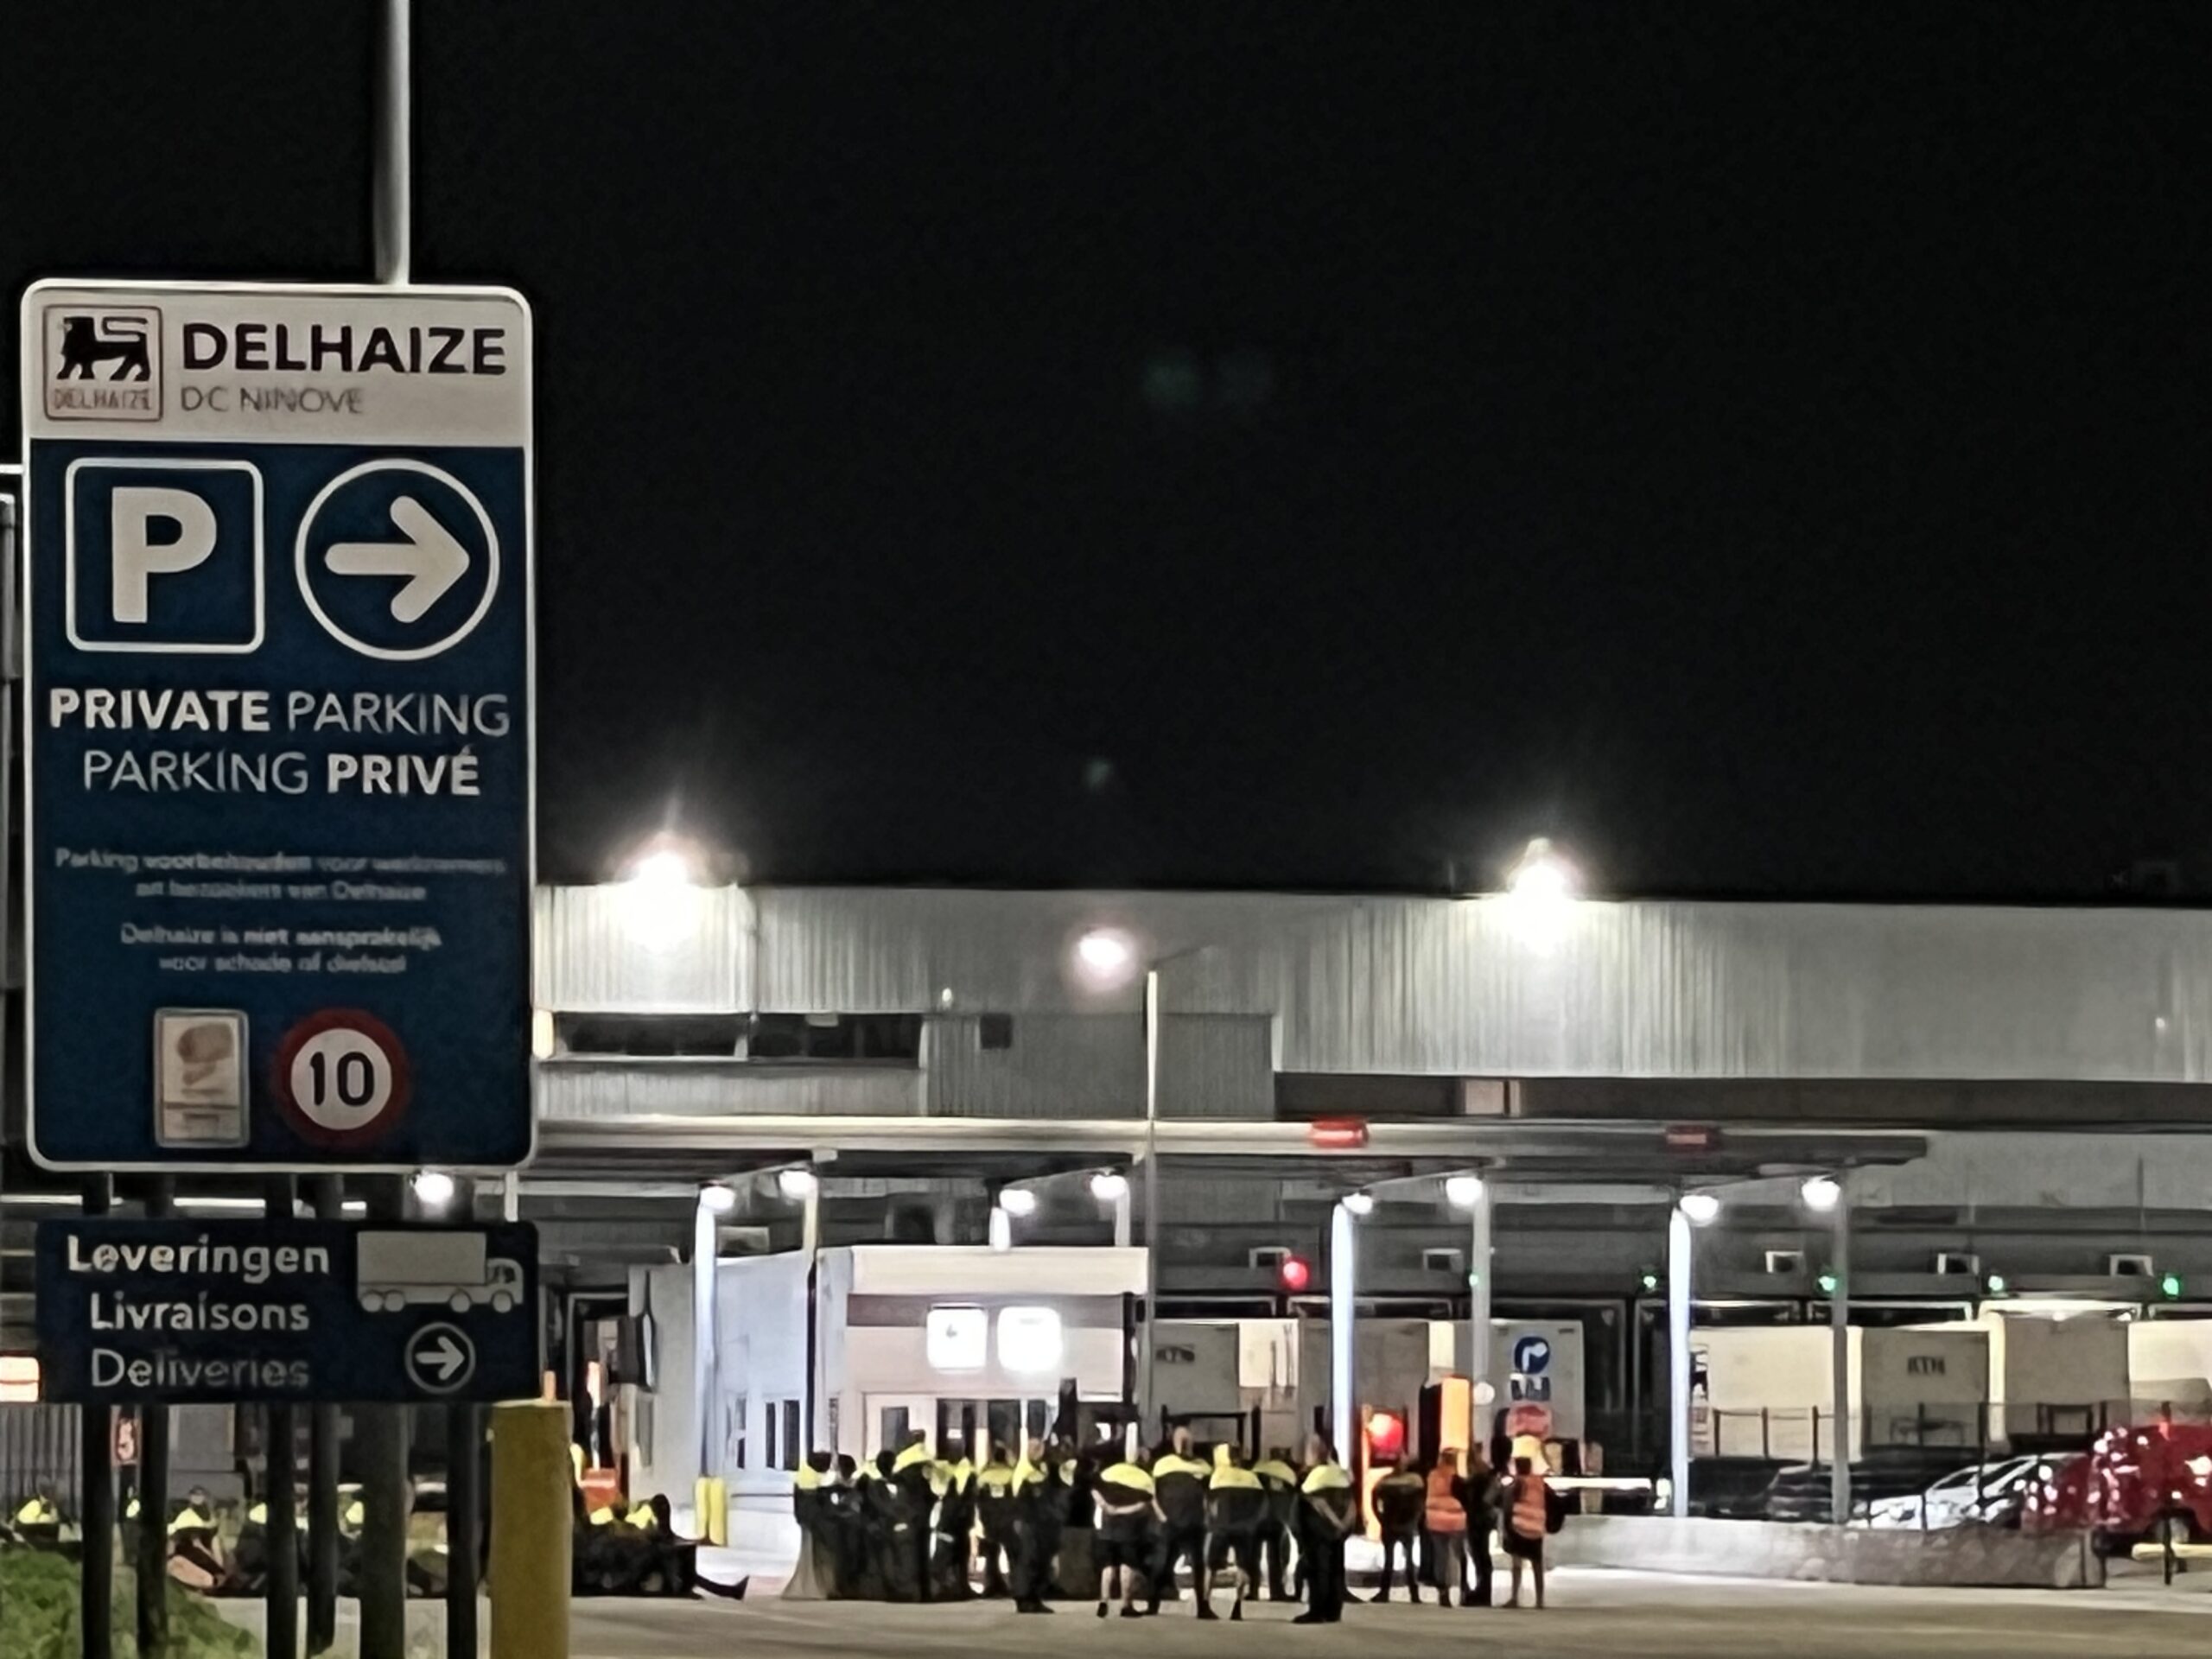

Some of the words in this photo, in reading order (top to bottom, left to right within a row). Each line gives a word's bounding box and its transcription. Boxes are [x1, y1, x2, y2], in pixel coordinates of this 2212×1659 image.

[182, 321, 508, 376] DELHAIZE
[54, 388, 151, 410] DELHAIZE
[181, 386, 229, 412] DC
[240, 386, 365, 415] NINOVE
[111, 486, 218, 624] P
[49, 689, 270, 732] PRIVATE
[288, 692, 511, 737] PARKING
[84, 750, 308, 794] PARKING
[327, 745, 481, 796] PRIVÉ
[308, 1051, 374, 1107] 10
[67, 1233, 330, 1284] Leveringen
[91, 1291, 310, 1331] Livraisons
[92, 1346, 310, 1388] Deliveries
